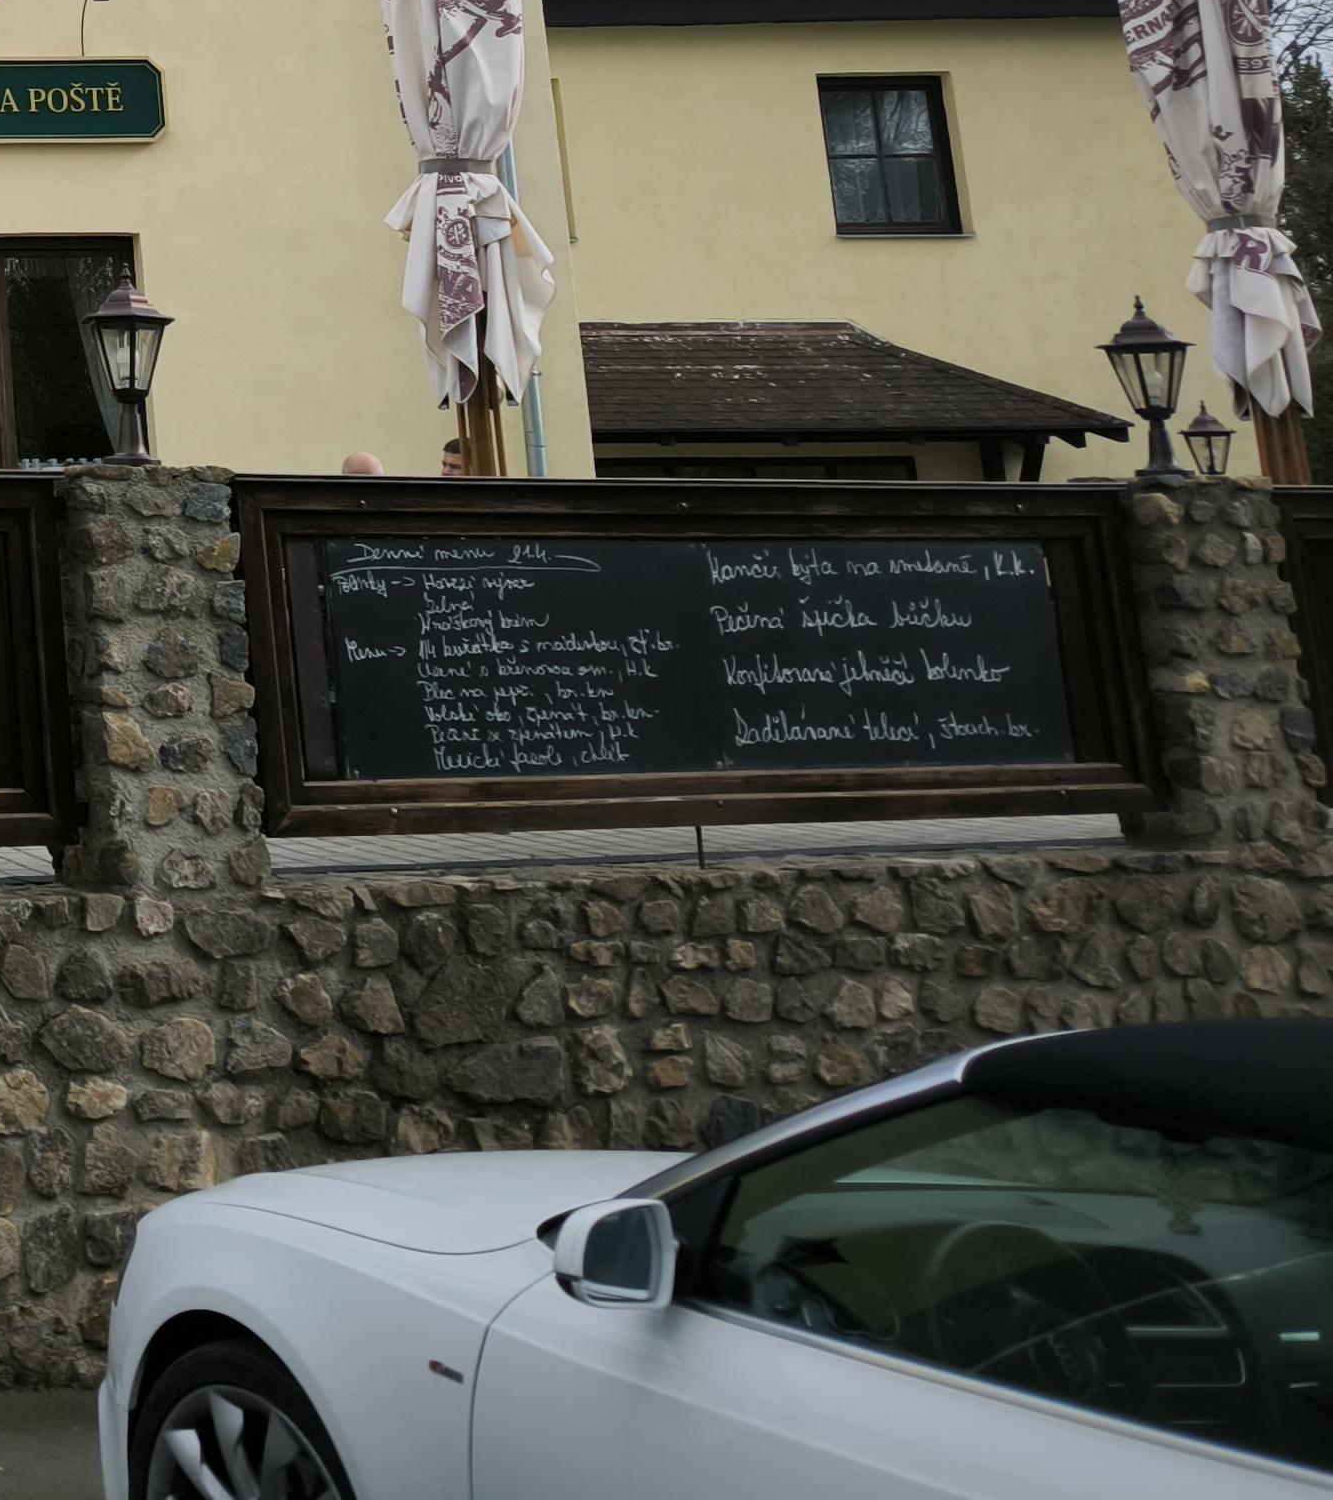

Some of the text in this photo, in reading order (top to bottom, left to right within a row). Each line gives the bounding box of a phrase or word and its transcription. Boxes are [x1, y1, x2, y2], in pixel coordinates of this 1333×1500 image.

[27, 81, 124, 114] POŠTĚ
[434, 547, 495, 561] menu
[846, 560, 882, 576] na
